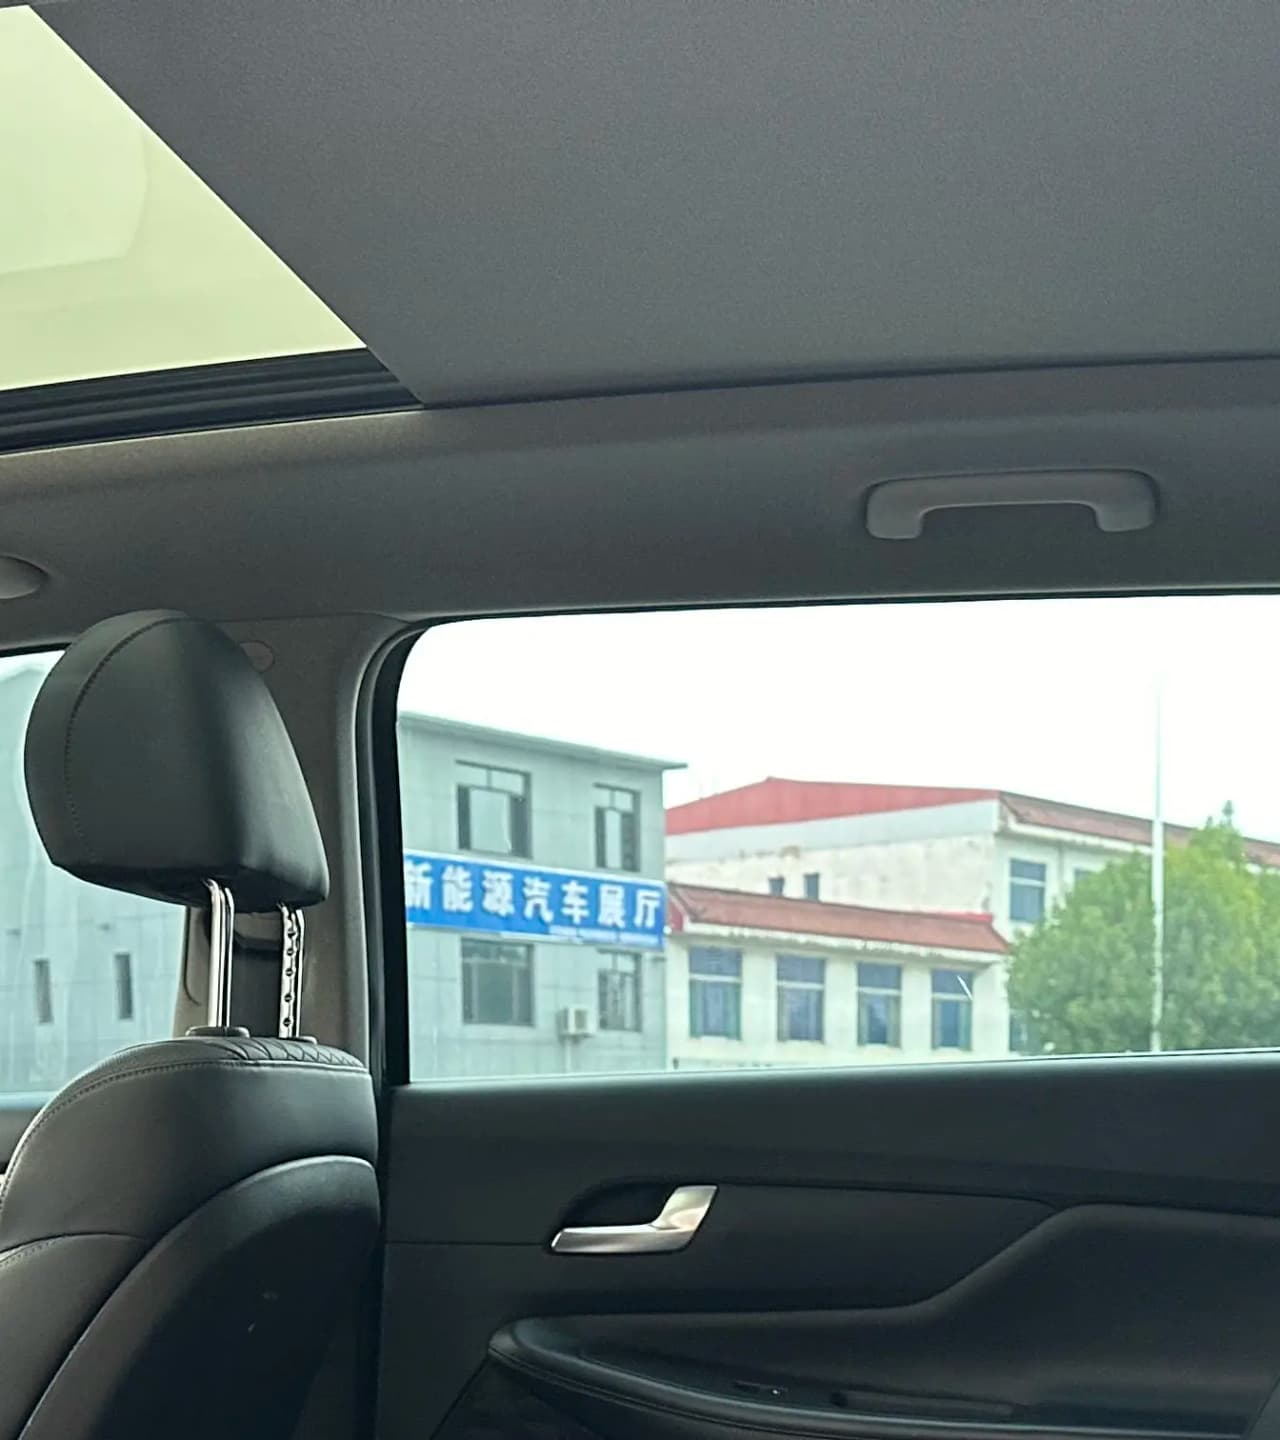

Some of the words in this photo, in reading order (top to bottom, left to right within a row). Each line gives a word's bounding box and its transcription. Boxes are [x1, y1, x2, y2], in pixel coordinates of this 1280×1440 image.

[406, 859, 661, 929] 新能源汽车展厅
